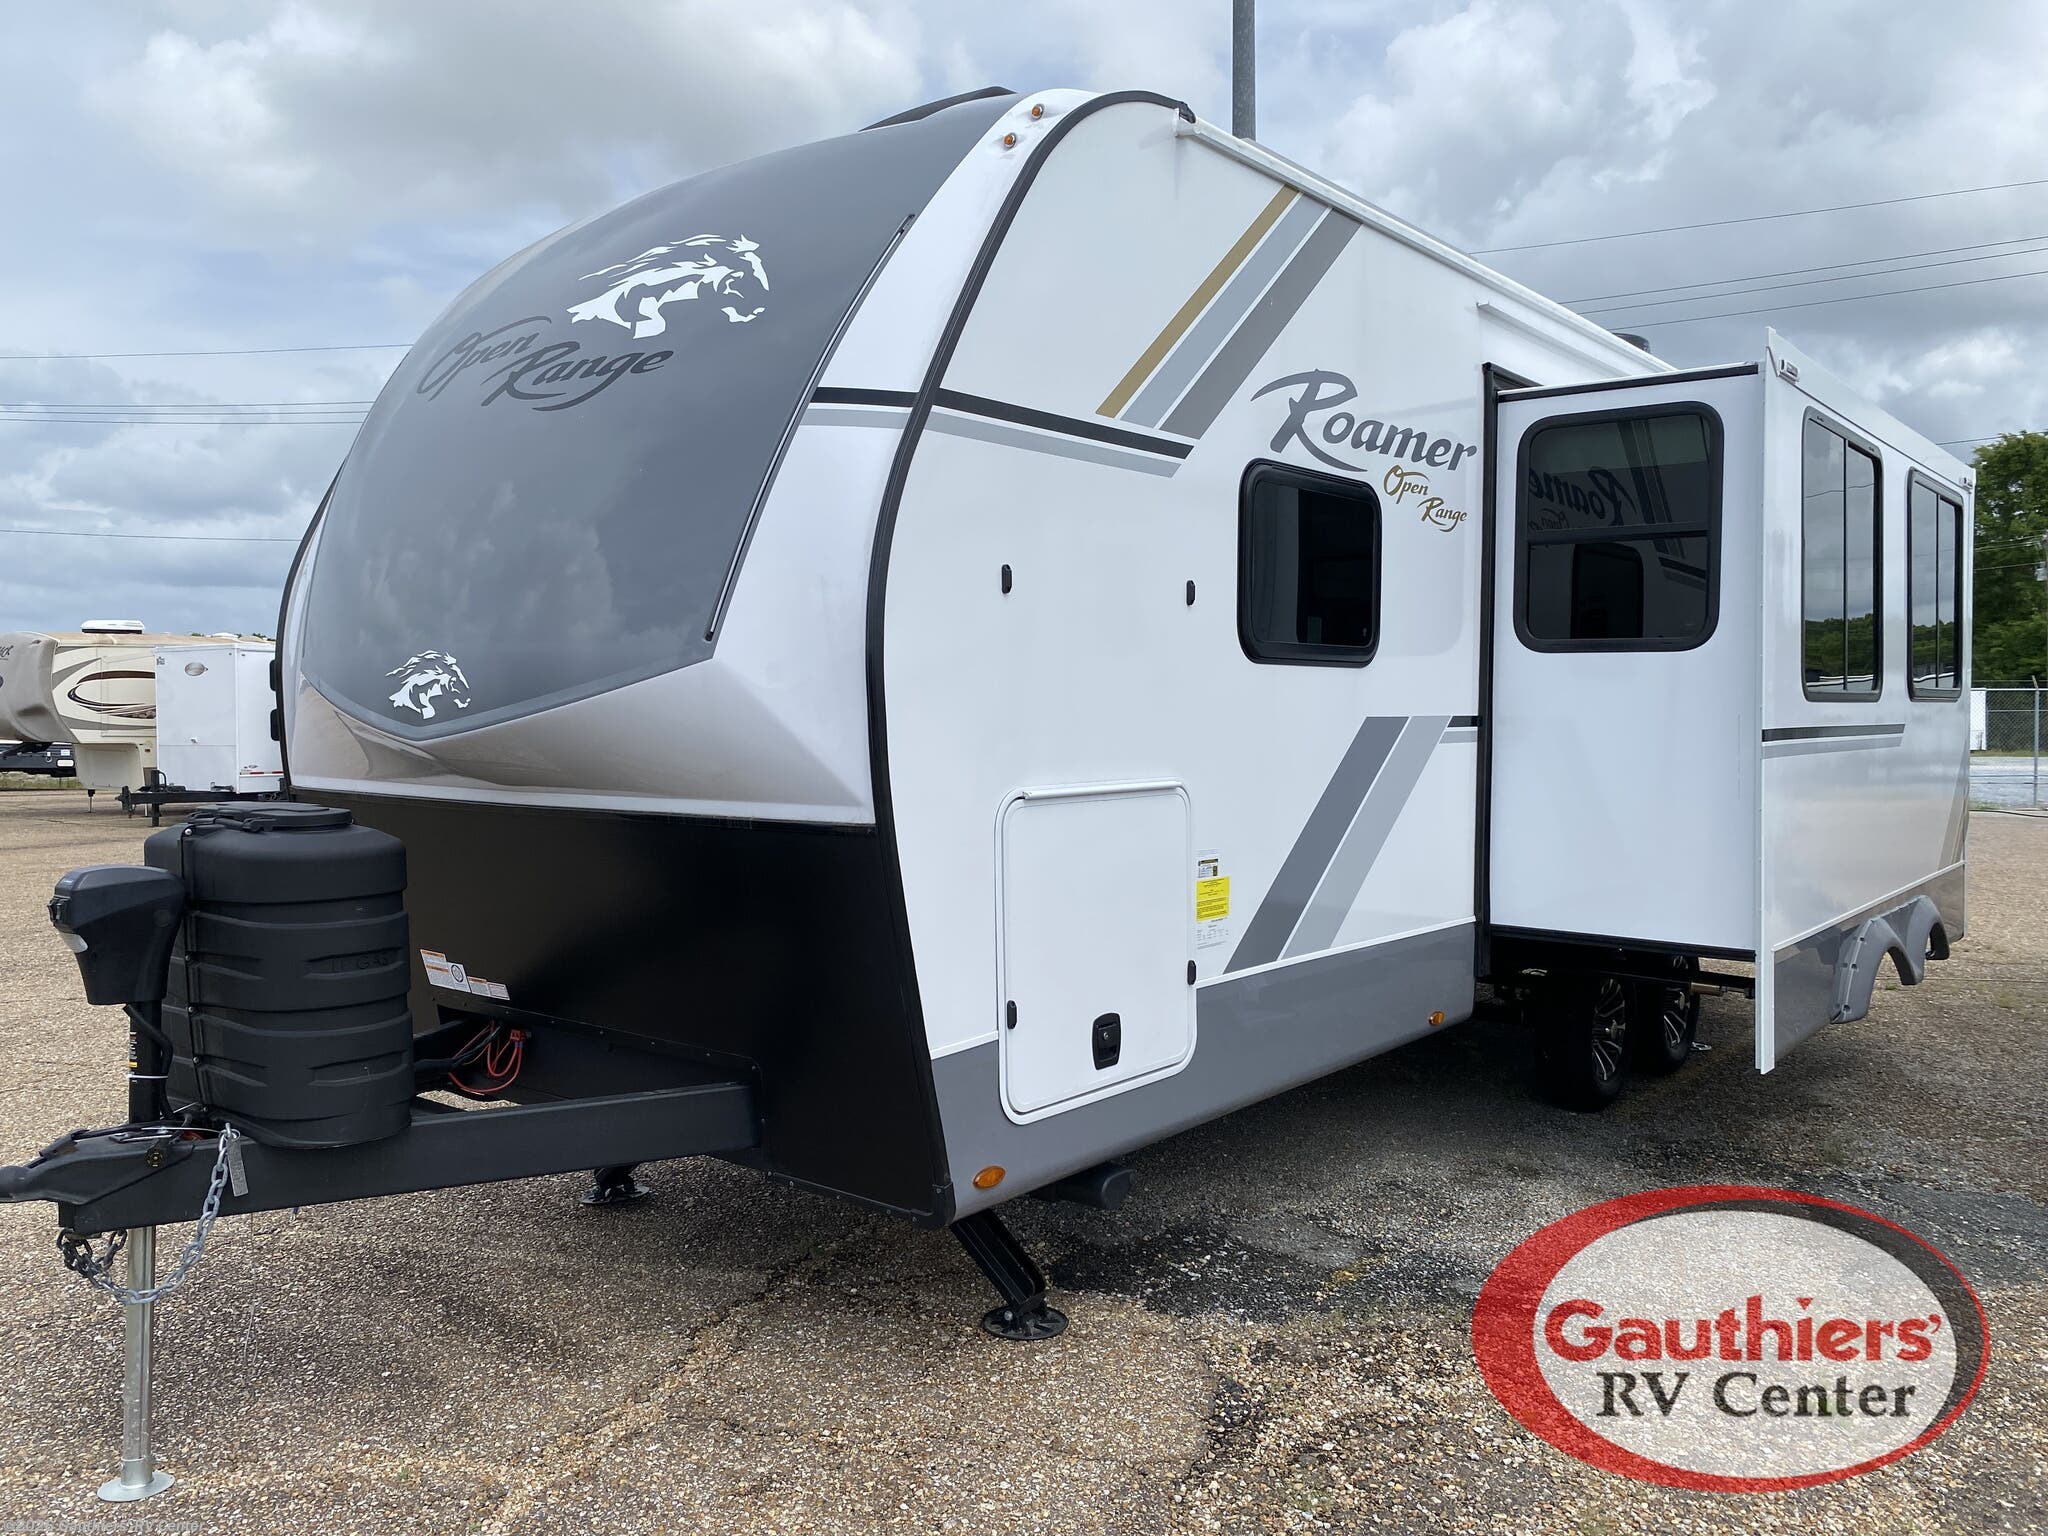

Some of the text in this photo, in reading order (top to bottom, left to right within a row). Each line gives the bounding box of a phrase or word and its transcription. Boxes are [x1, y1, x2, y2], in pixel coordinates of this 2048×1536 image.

[416, 315, 674, 412] Open Range
[1250, 368, 1478, 473] Roamer
[1383, 464, 1468, 533] Open Range
